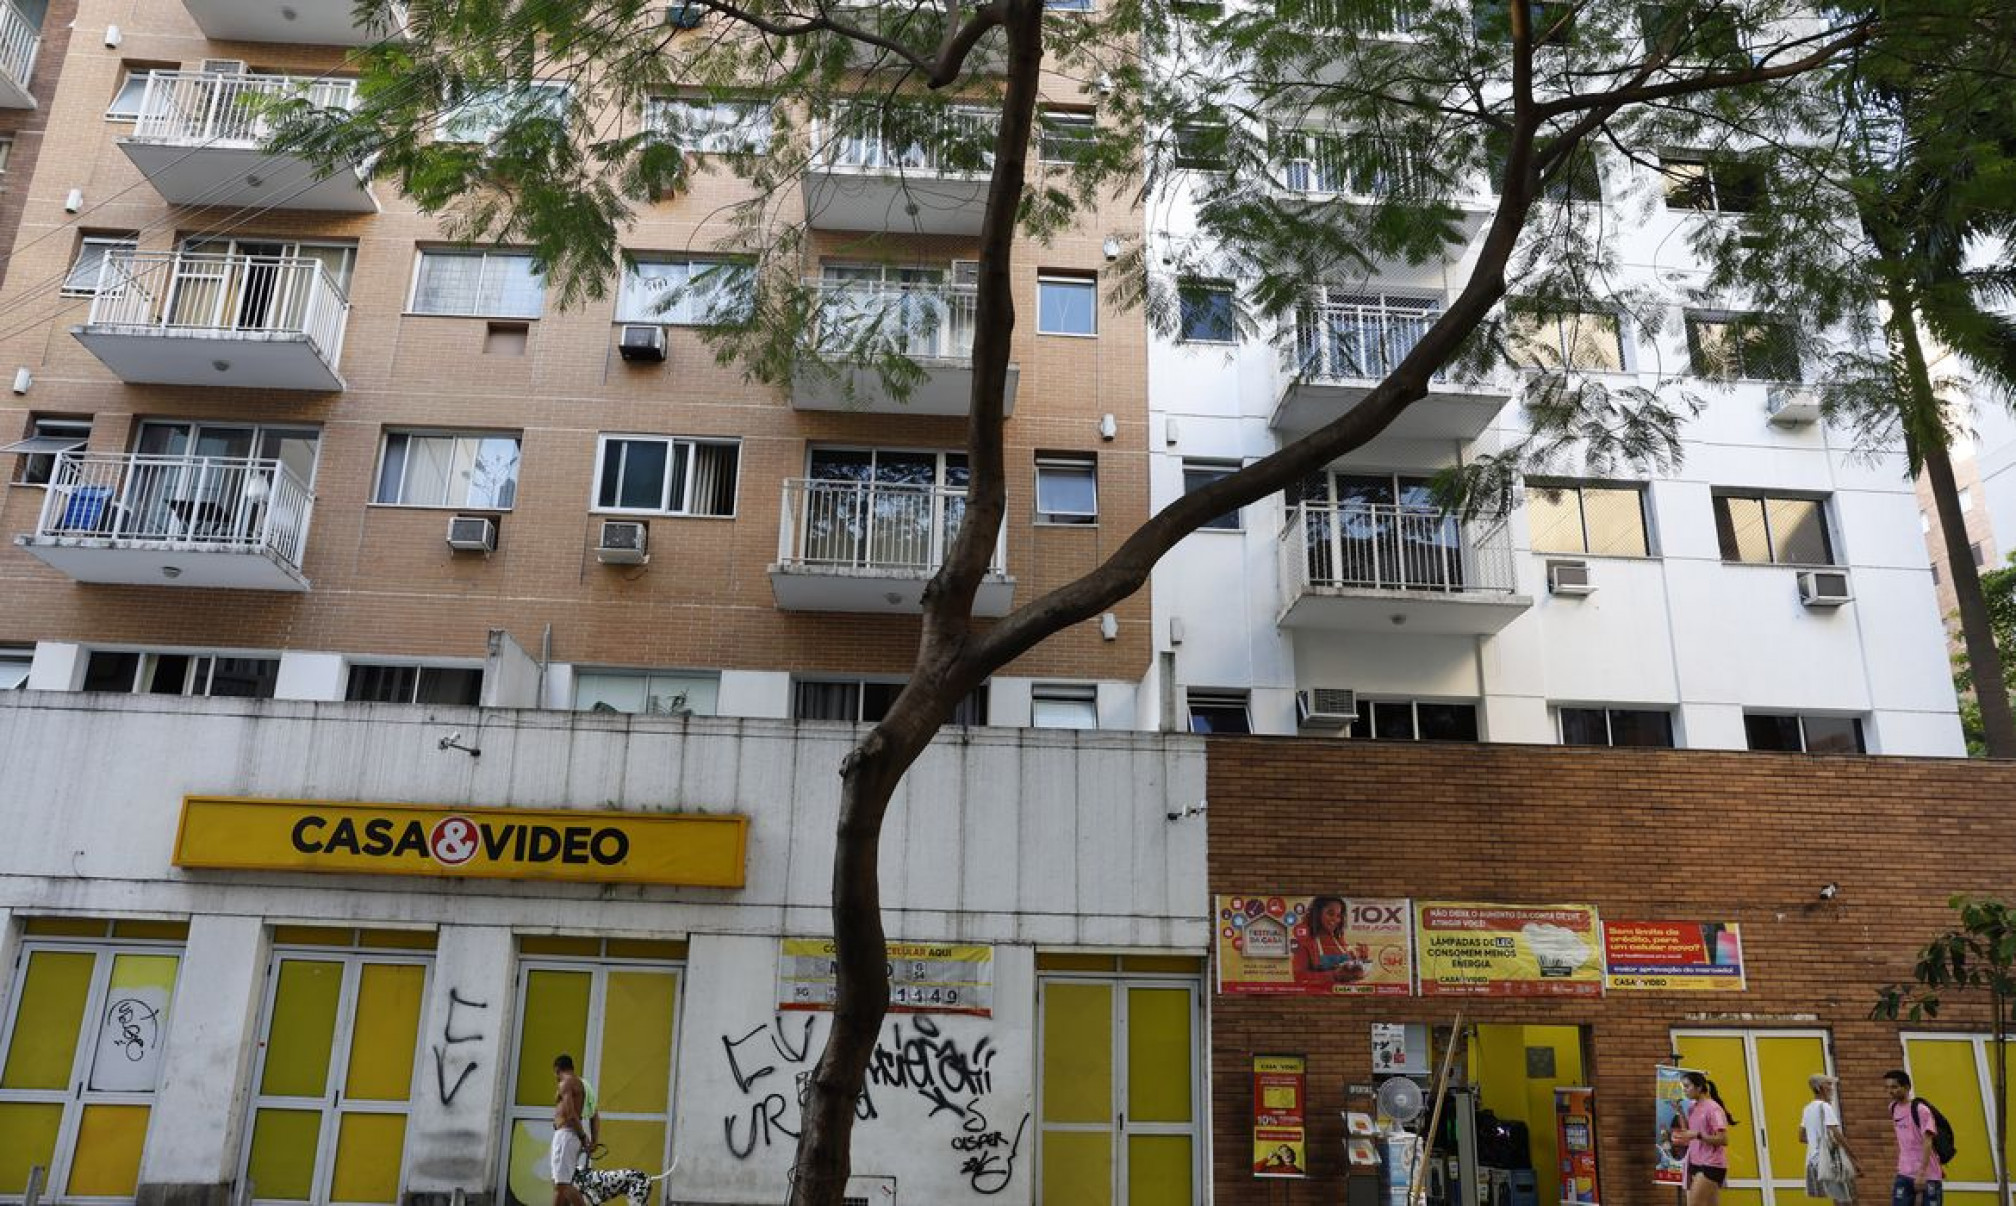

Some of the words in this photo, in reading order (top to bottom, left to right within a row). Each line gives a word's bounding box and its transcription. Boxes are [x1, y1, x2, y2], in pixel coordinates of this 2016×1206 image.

[1351, 906, 1404, 923] 10X
[1430, 936, 1480, 947] LÂMPADAS
[1483, 938, 1495, 947] DE
[1427, 948, 1481, 957] CONSOMEM
[1484, 949, 1516, 958] MENOS
